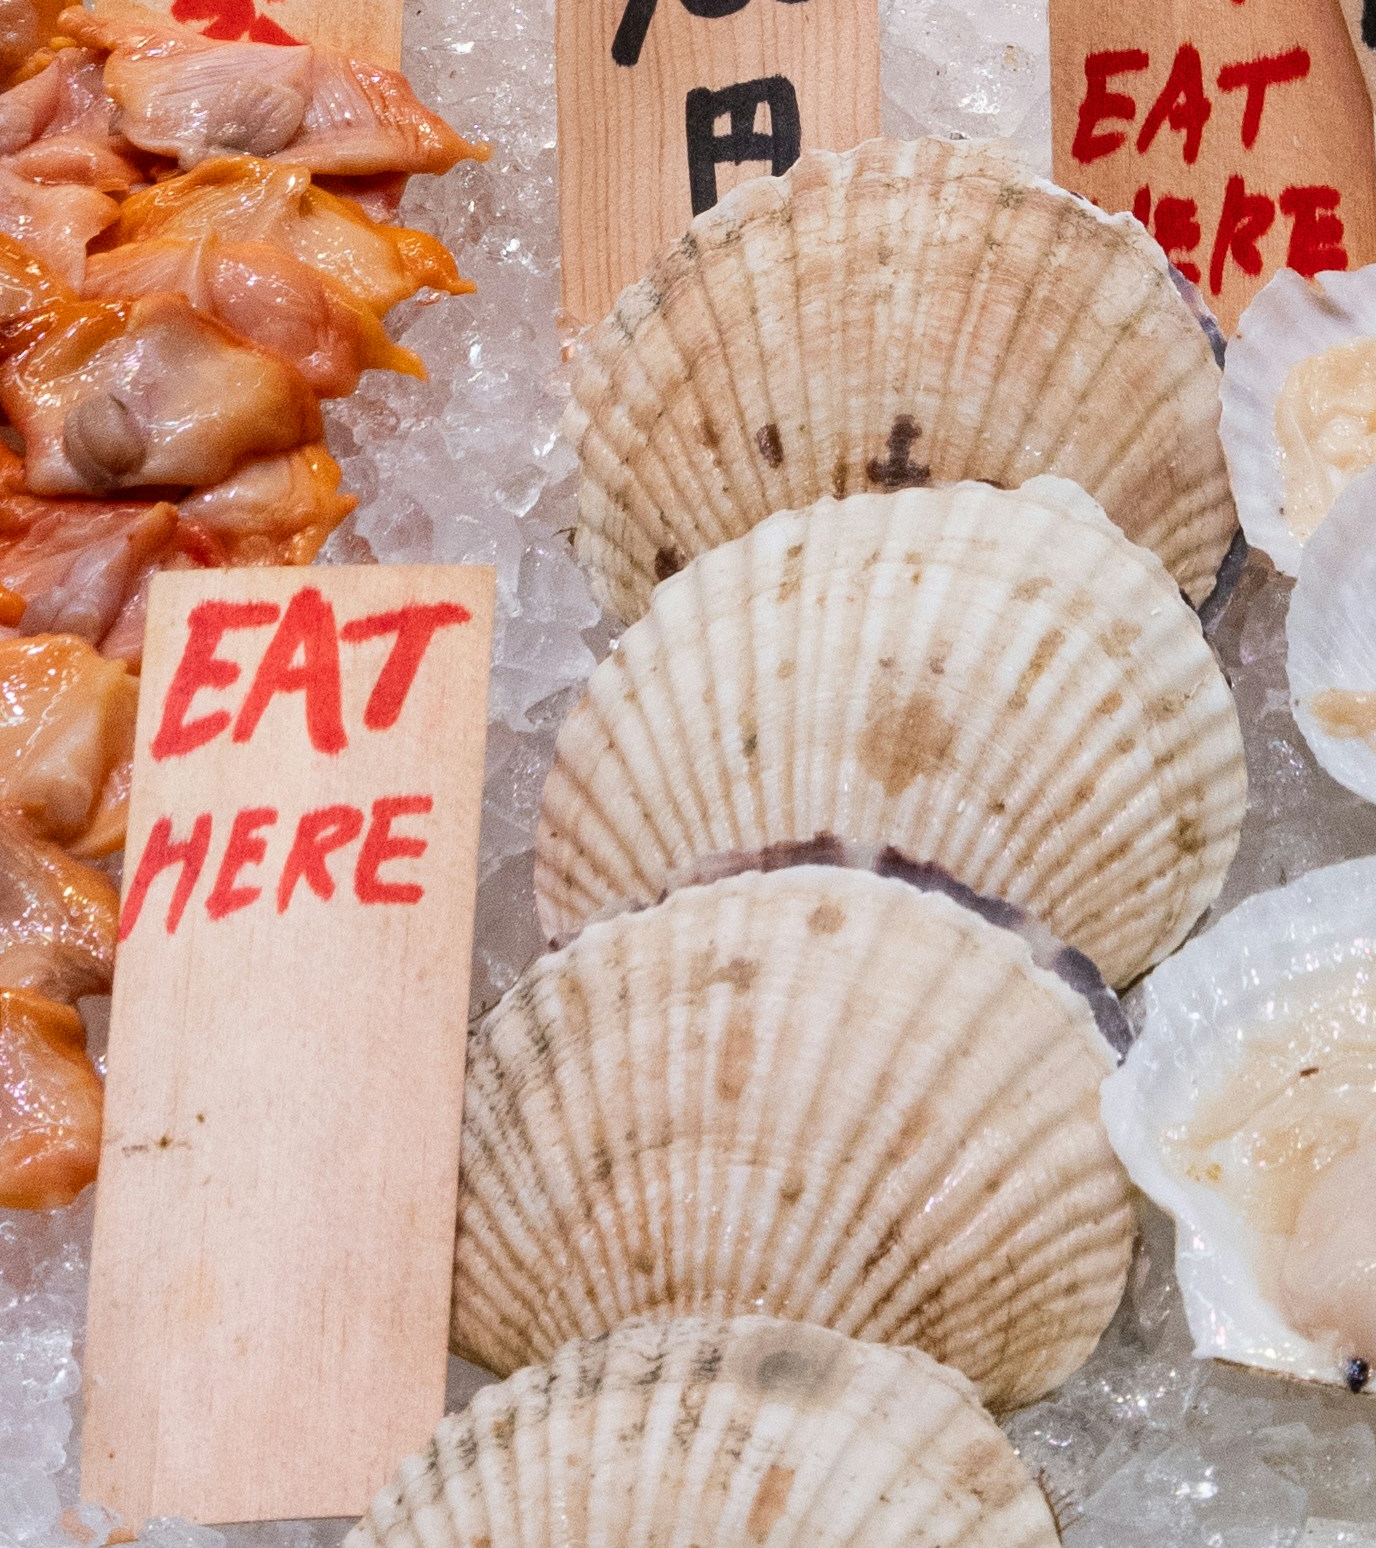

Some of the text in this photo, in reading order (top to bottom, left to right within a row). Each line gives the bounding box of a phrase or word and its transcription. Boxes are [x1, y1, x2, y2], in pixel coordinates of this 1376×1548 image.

[686, 74, 802, 216] 円
[1071, 41, 1312, 167] EAT
[1133, 175, 1349, 296] ERE
[151, 587, 471, 757] EAT
[119, 795, 433, 941] HERE
